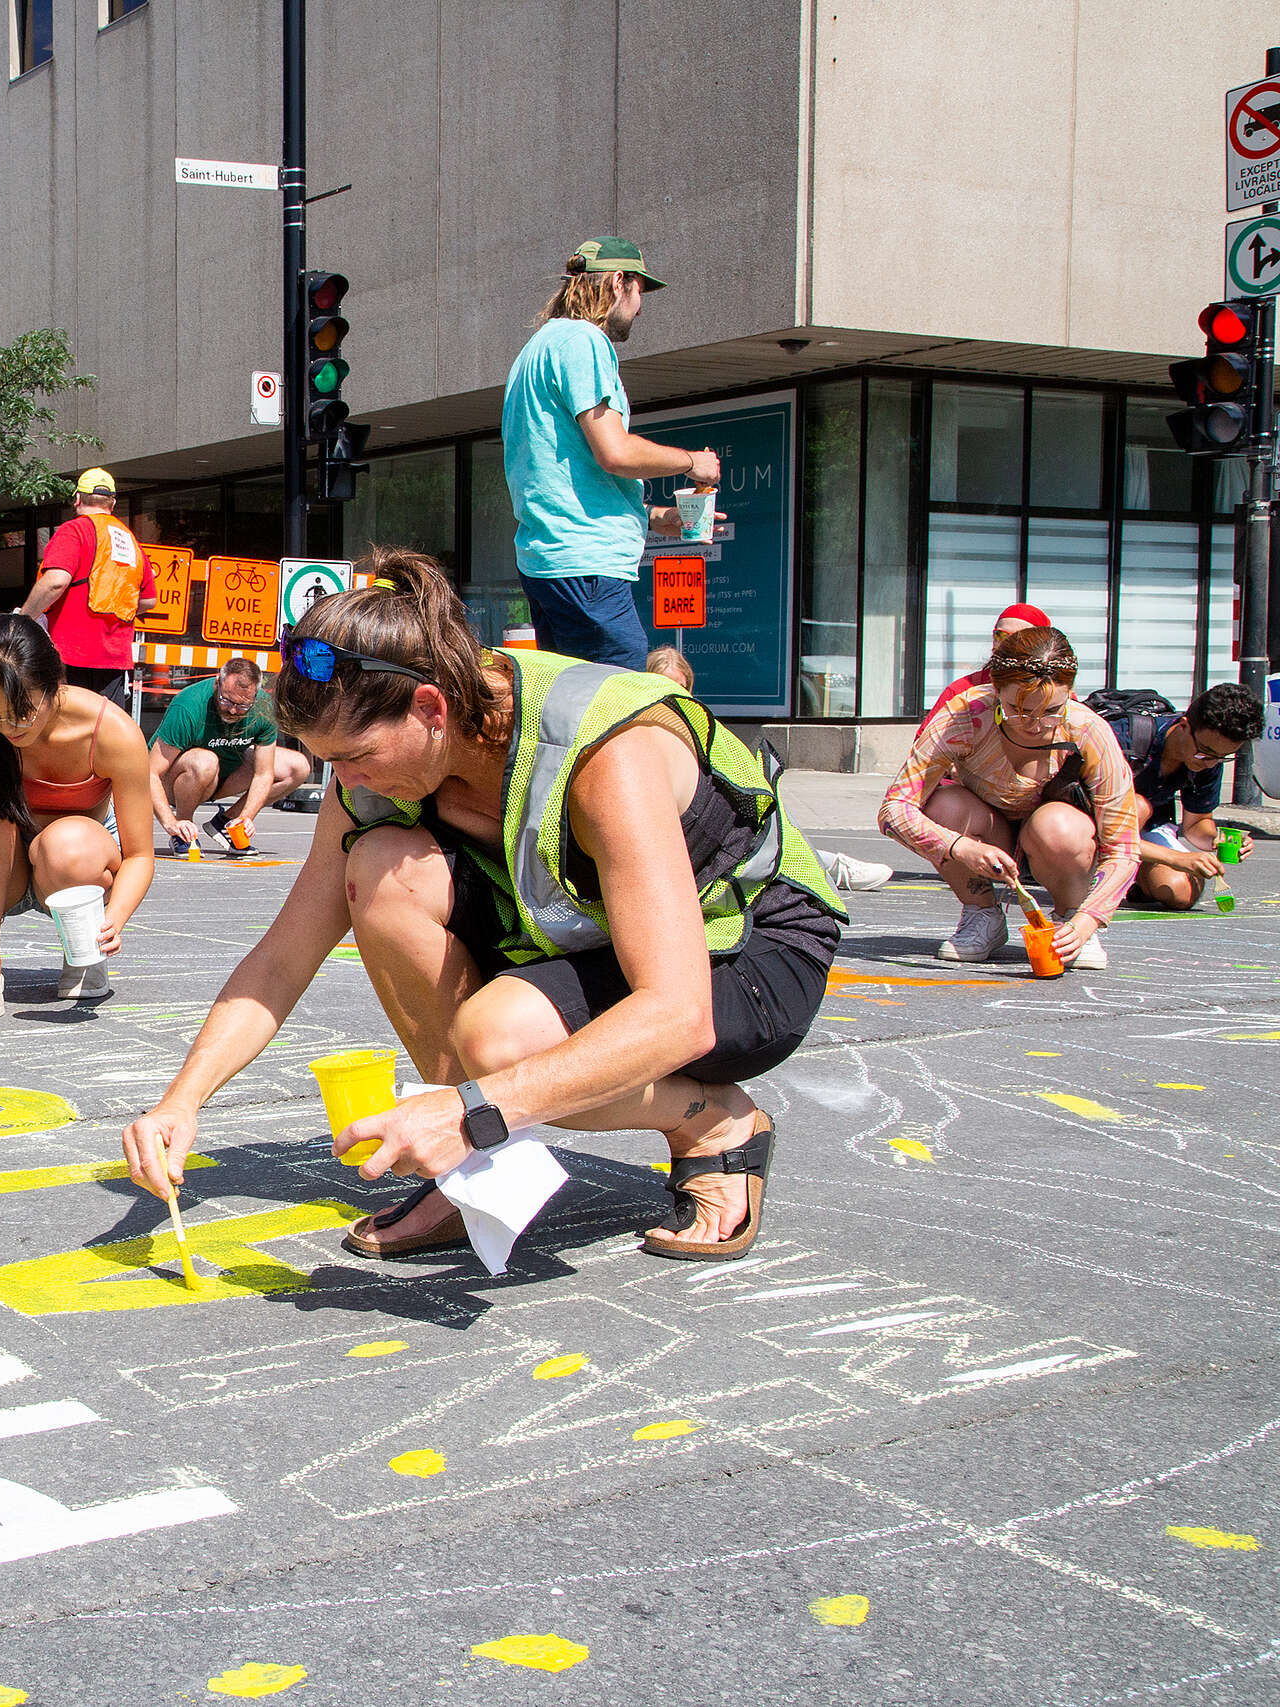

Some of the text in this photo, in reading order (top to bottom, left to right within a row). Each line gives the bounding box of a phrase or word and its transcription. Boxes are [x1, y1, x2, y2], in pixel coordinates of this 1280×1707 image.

[181, 167, 253, 184] Saint-Hubert
[657, 571, 702, 587] TROTTOIR
[225, 597, 261, 613] VOIE
[663, 594, 695, 613] BARRÉ
[209, 620, 273, 638] BARRÉE
